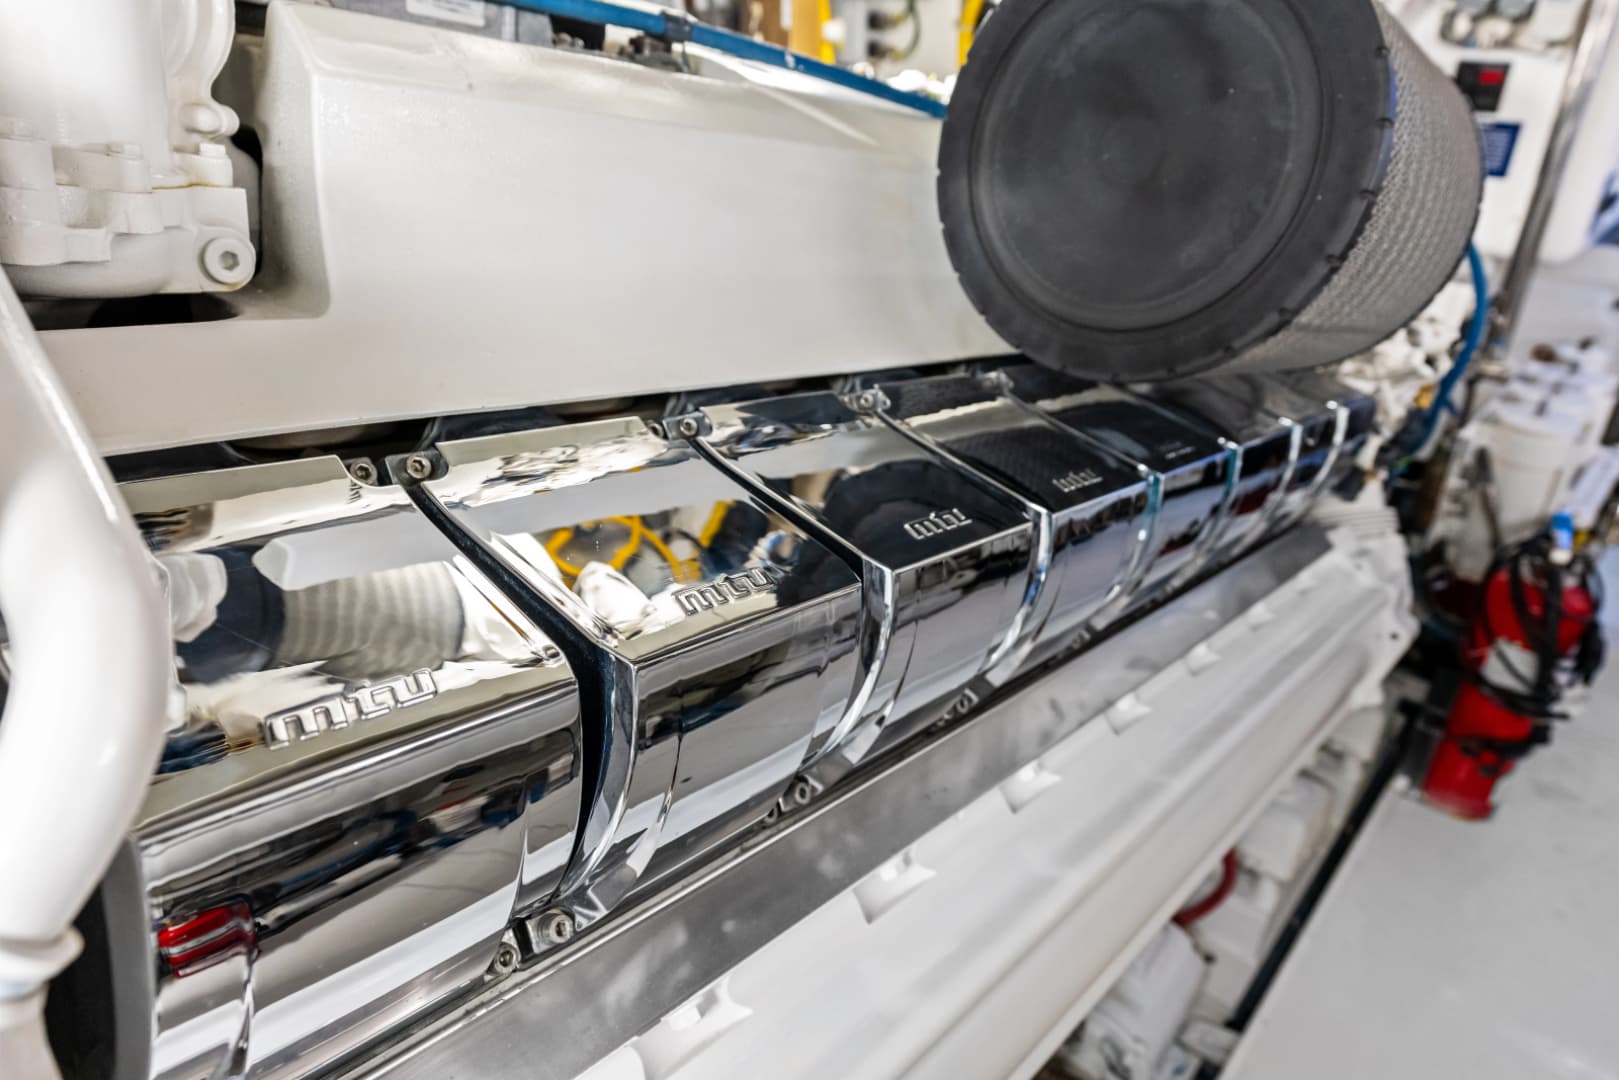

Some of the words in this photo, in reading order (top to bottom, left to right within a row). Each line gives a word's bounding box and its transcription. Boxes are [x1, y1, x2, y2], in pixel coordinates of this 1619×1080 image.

[904, 507, 973, 539] mtu
[674, 567, 785, 616] mtu
[264, 668, 437, 749] mtu
